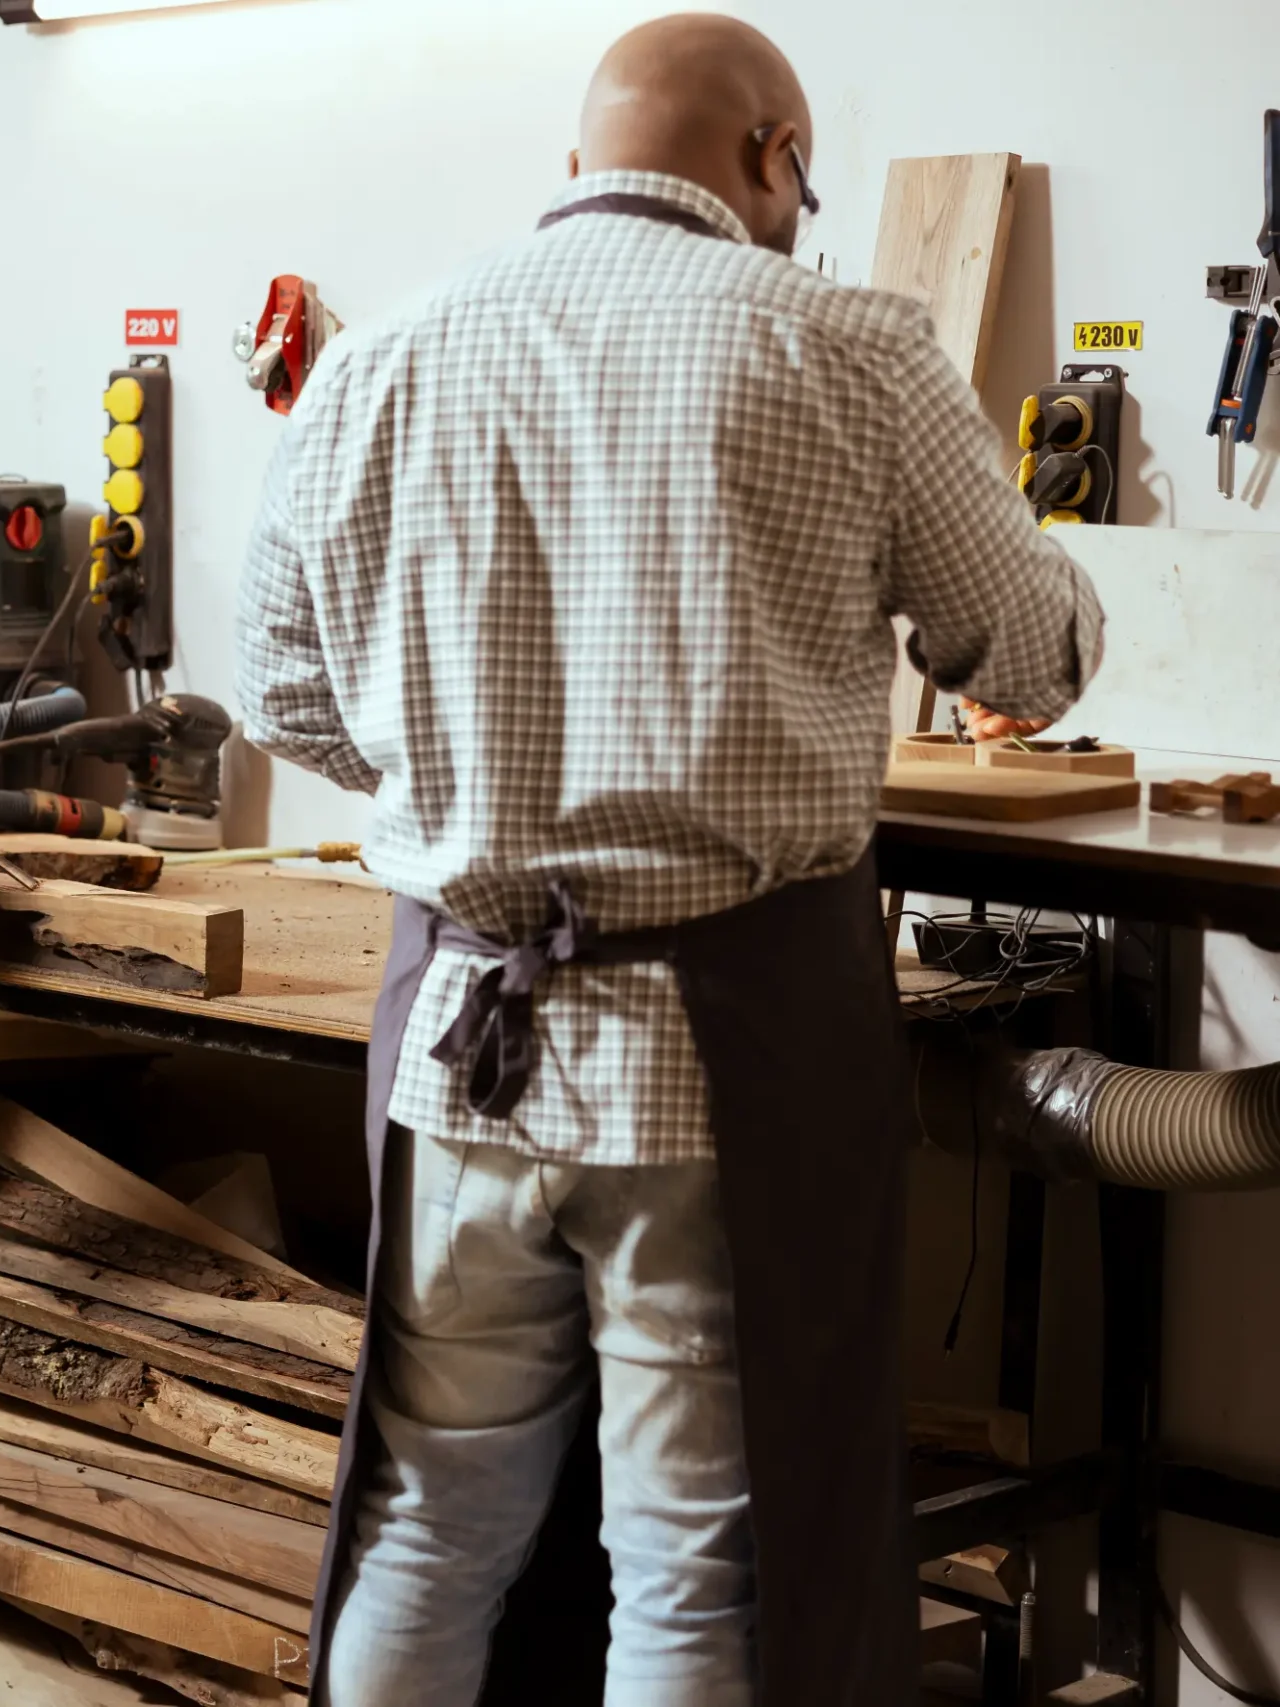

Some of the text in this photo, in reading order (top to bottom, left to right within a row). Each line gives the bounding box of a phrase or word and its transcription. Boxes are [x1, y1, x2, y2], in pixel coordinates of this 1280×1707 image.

[128, 317, 176, 337] 220 V
[1090, 326, 1124, 347] 230
